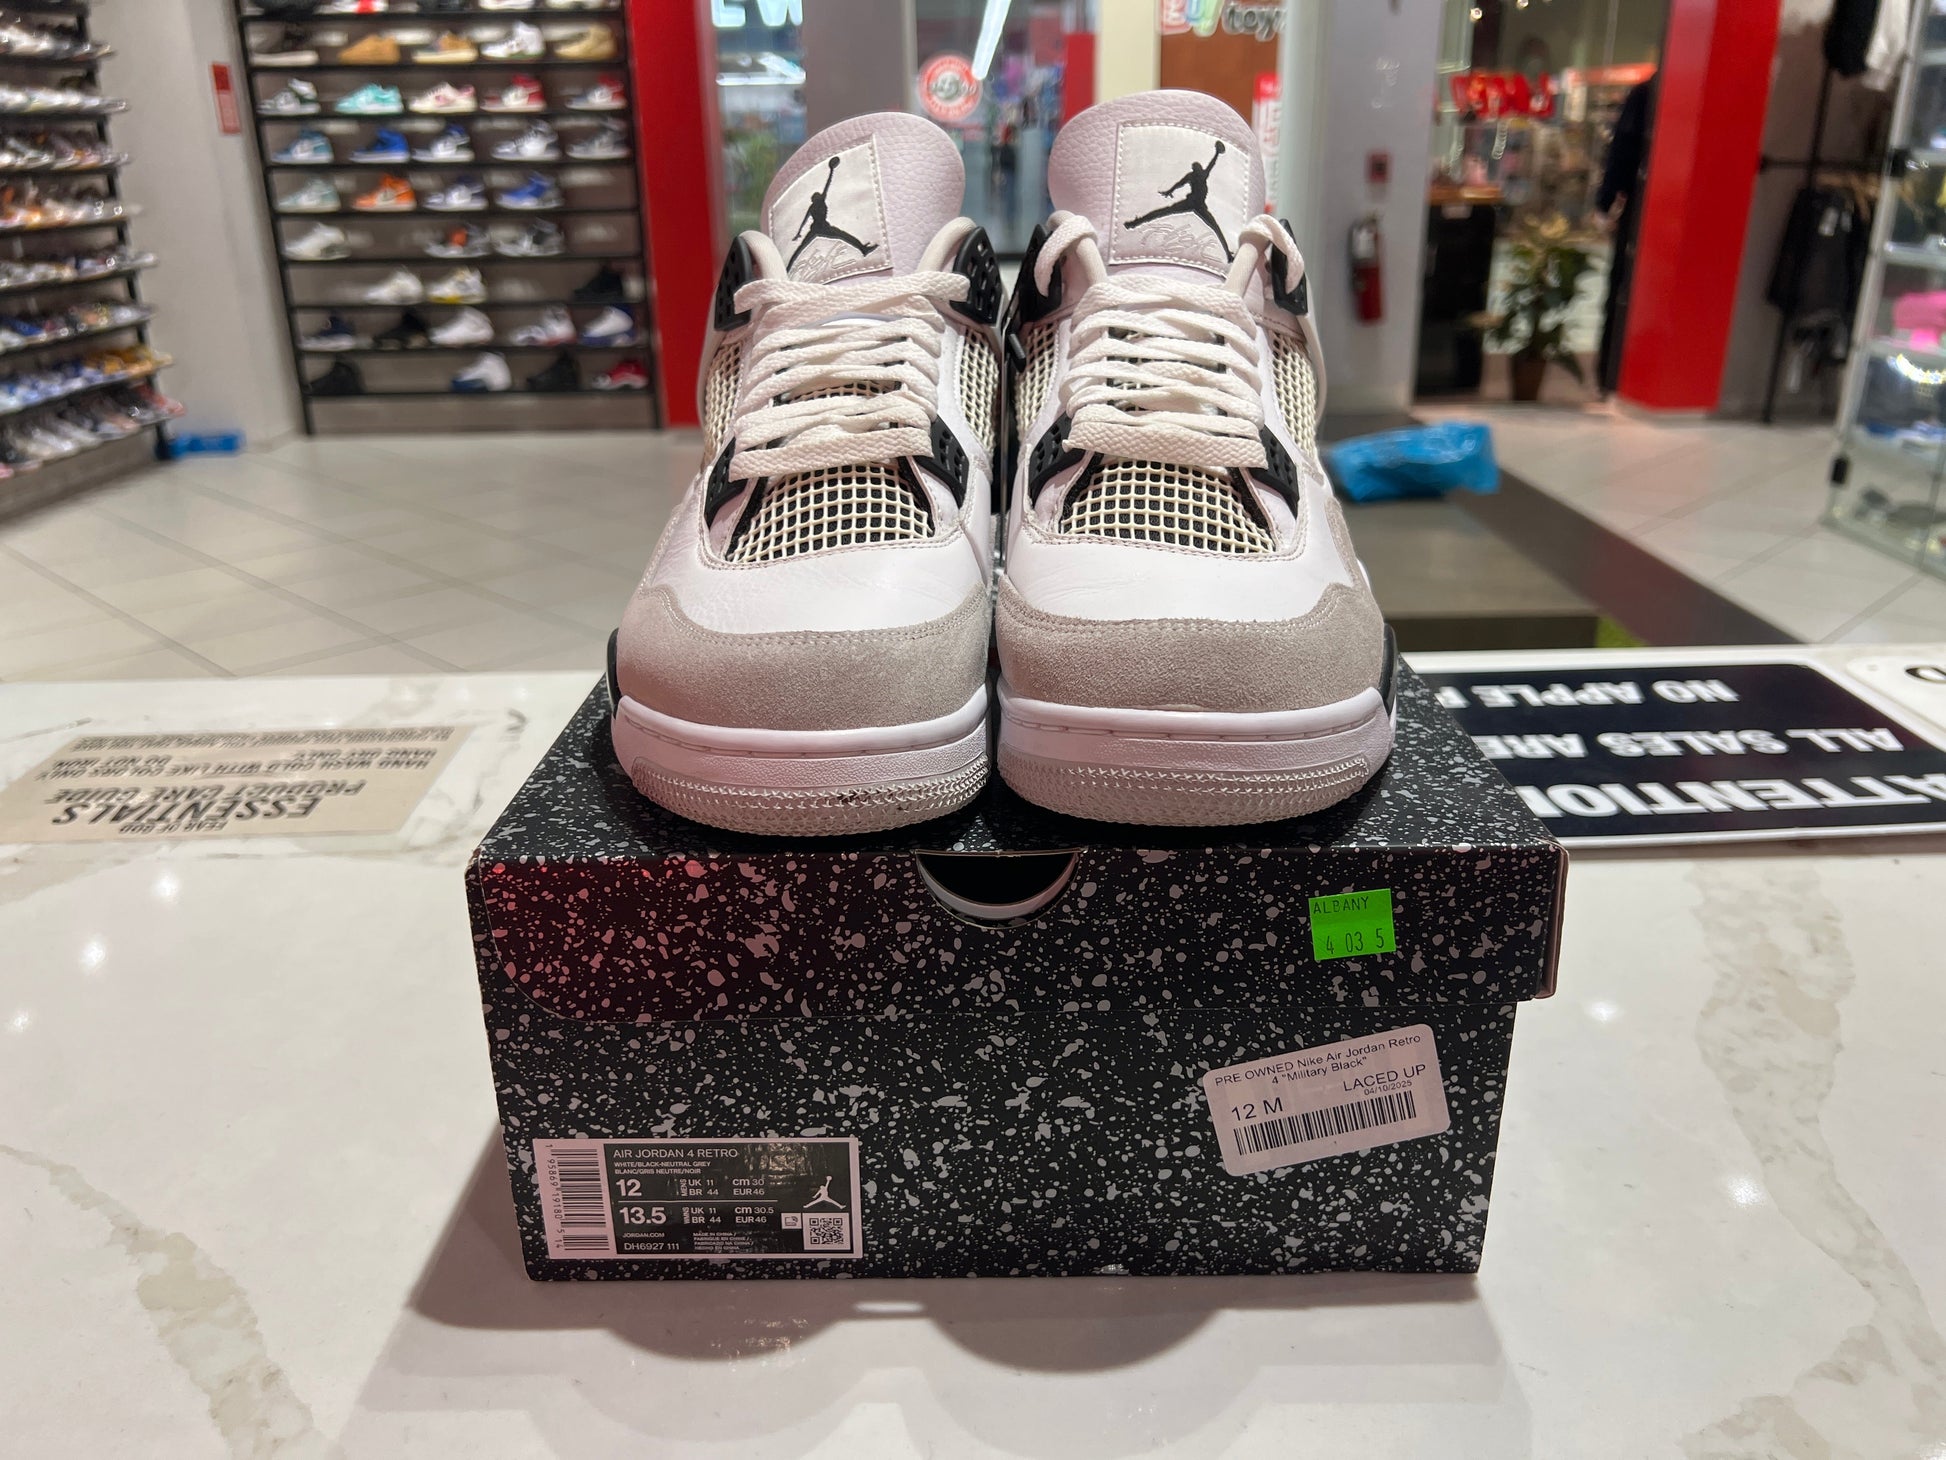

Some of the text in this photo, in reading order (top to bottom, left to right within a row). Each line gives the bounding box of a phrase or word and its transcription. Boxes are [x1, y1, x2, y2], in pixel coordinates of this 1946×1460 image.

[1471, 681, 1645, 708] APPLE
[1652, 679, 1740, 703] NO
[1597, 729, 1790, 757] SALES
[1785, 728, 1904, 752] ALL
[101, 756, 141, 769] NOT
[141, 755, 173, 767] DO
[212, 762, 262, 775] WITH
[263, 761, 316, 773] COLD
[319, 760, 372, 770] WASH
[377, 760, 431, 770] HAND
[89, 766, 166, 778] COLORS
[166, 764, 211, 777] LIKE
[45, 779, 367, 804] PRODUCT CARE GUIDE
[52, 796, 323, 825] ESSENTIALS
[158, 821, 181, 833] OF
[1313, 896, 1369, 914] ALBANY
[1326, 936, 1334, 954] 4
[1215, 1035, 1421, 1086] PRE OWNED Nike Air Jordan Retro
[1272, 1056, 1367, 1084] 4 "Military Black"
[1343, 1064, 1426, 1092] LACED UP
[1364, 1080, 1412, 1096] 04/10/2025
[1231, 1097, 1283, 1121] 12 M
[613, 1149, 738, 1158] AIR JORDAN 4 RETRO
[616, 1179, 642, 1197] 12
[732, 1178, 765, 1186] cm 30
[689, 1188, 719, 1196] BR 44
[619, 1206, 667, 1225] 13.5
[735, 1206, 752, 1214] cm
[692, 1216, 705, 1224] BR
